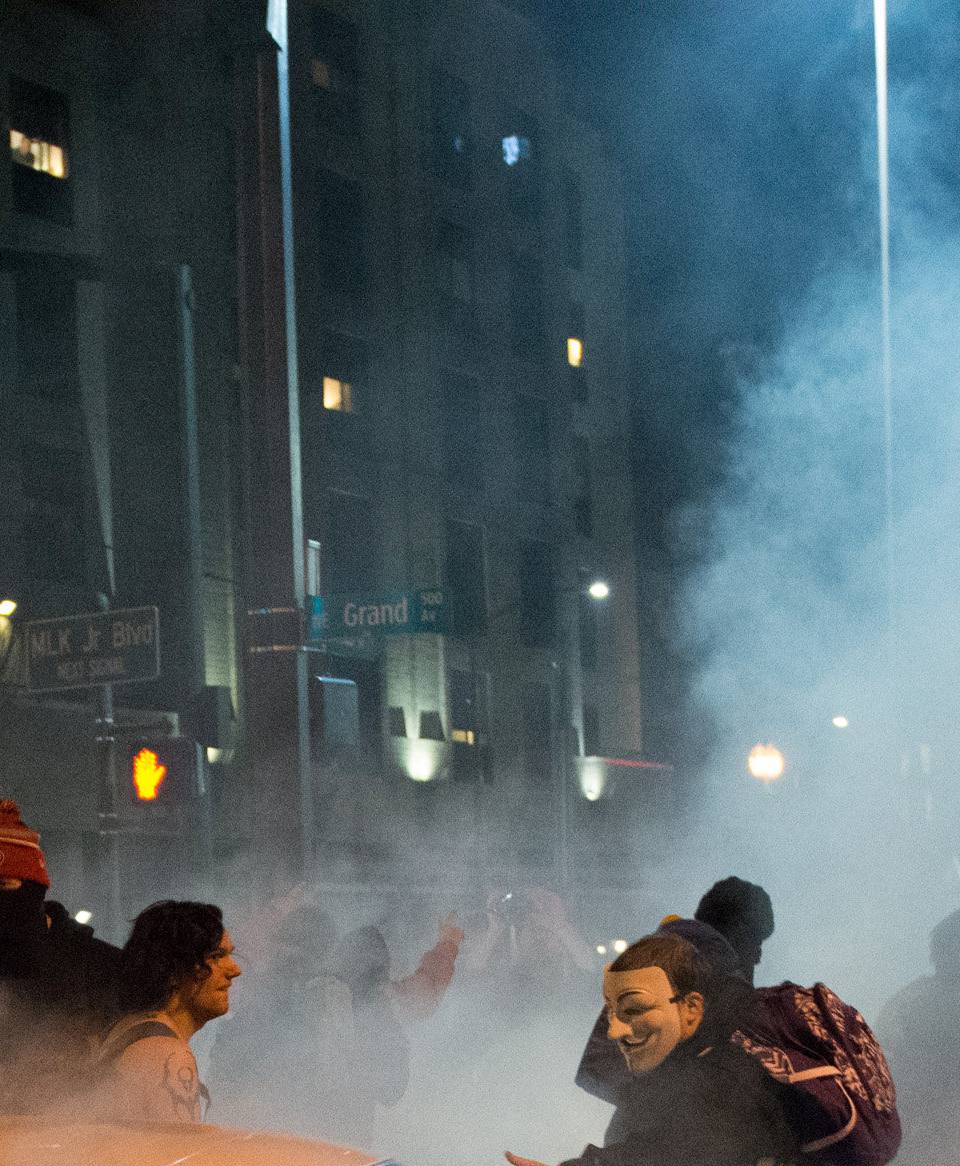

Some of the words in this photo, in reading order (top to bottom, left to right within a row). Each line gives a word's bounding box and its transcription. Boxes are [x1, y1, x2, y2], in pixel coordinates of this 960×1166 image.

[343, 596, 409, 627] Grand
[31, 626, 72, 656] MLK
[82, 623, 102, 652] Jr
[111, 621, 153, 649] Blvd
